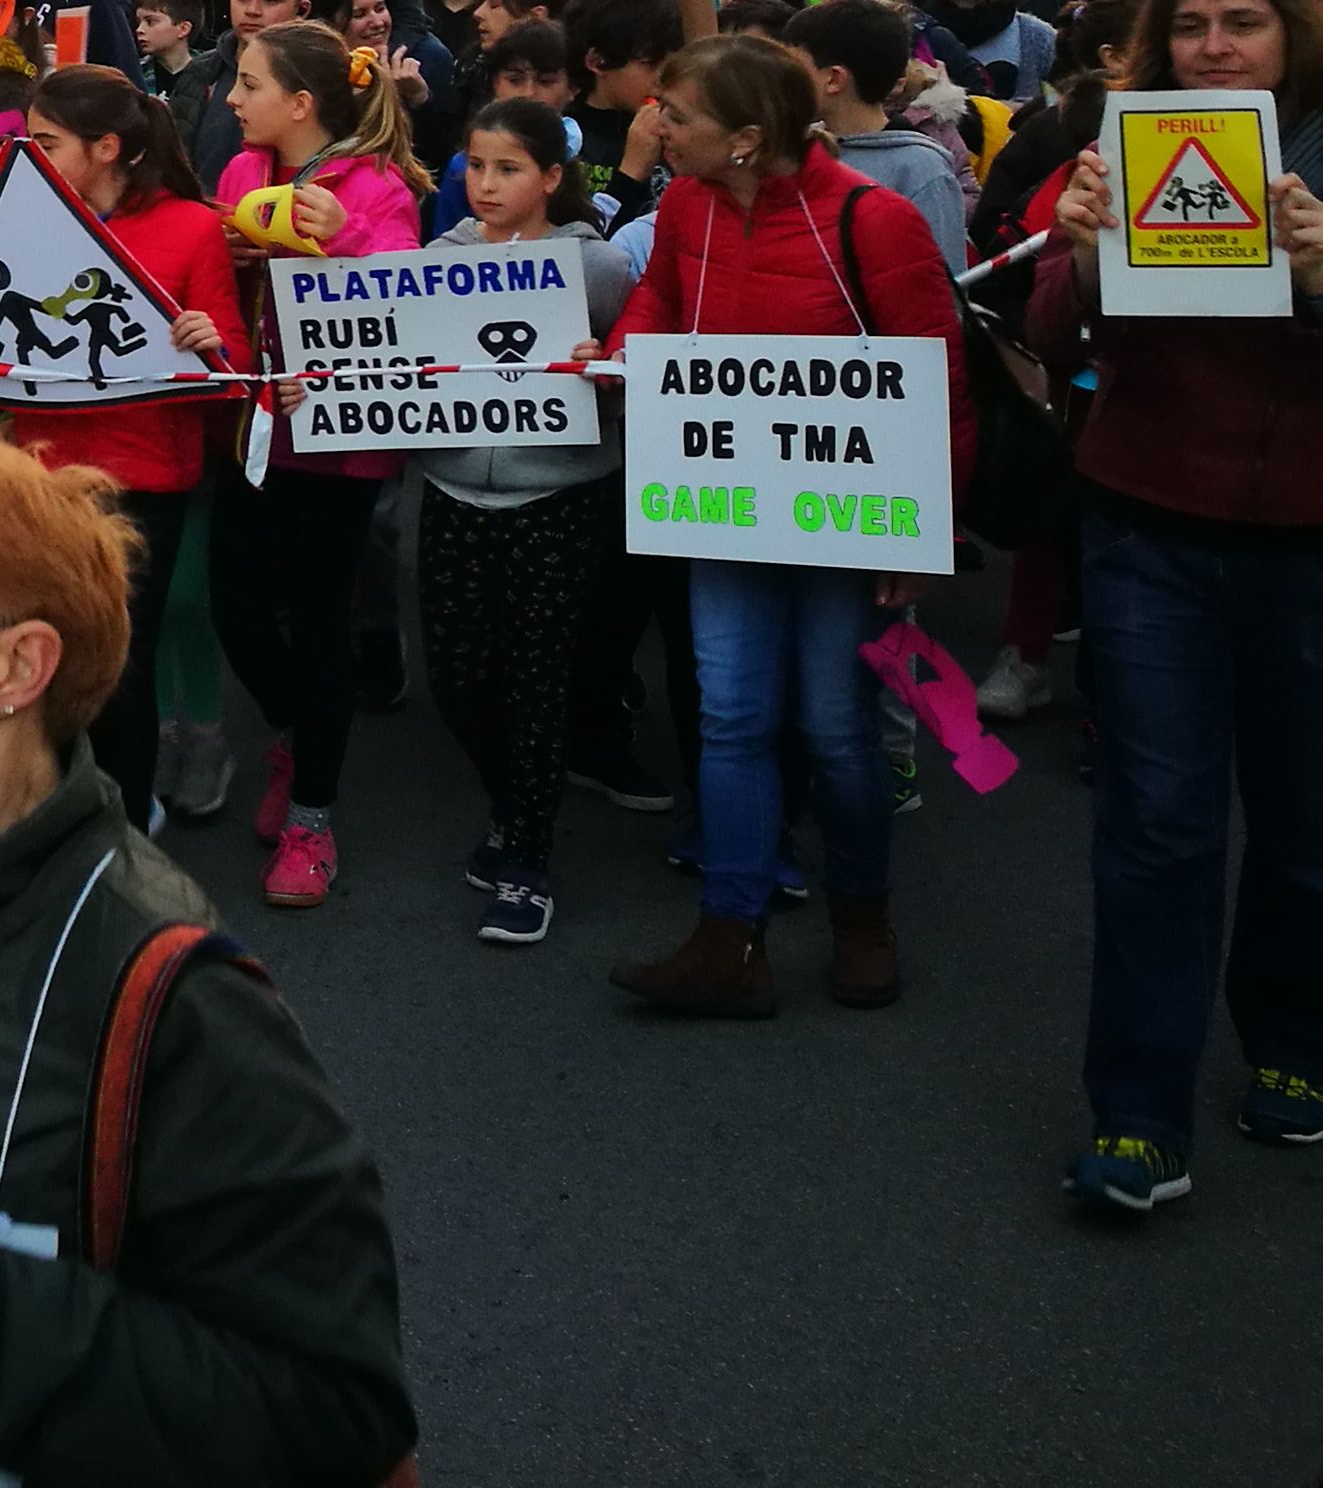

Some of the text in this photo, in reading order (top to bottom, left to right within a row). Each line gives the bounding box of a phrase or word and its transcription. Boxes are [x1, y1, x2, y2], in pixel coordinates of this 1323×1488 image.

[1157, 118, 1225, 133] PERILL!
[1138, 246, 1260, 258] 700m de L'ESCOLA
[1157, 234, 1227, 246] ABOCADOR
[291, 257, 567, 304] PLATAFORMA
[299, 307, 398, 350] RUBÍ
[304, 355, 439, 392] SENSE
[660, 357, 906, 400] ABOCADOR
[310, 397, 569, 437] ABOCADORS
[682, 420, 875, 464] DE TMA
[641, 482, 921, 537] GAME OVER
